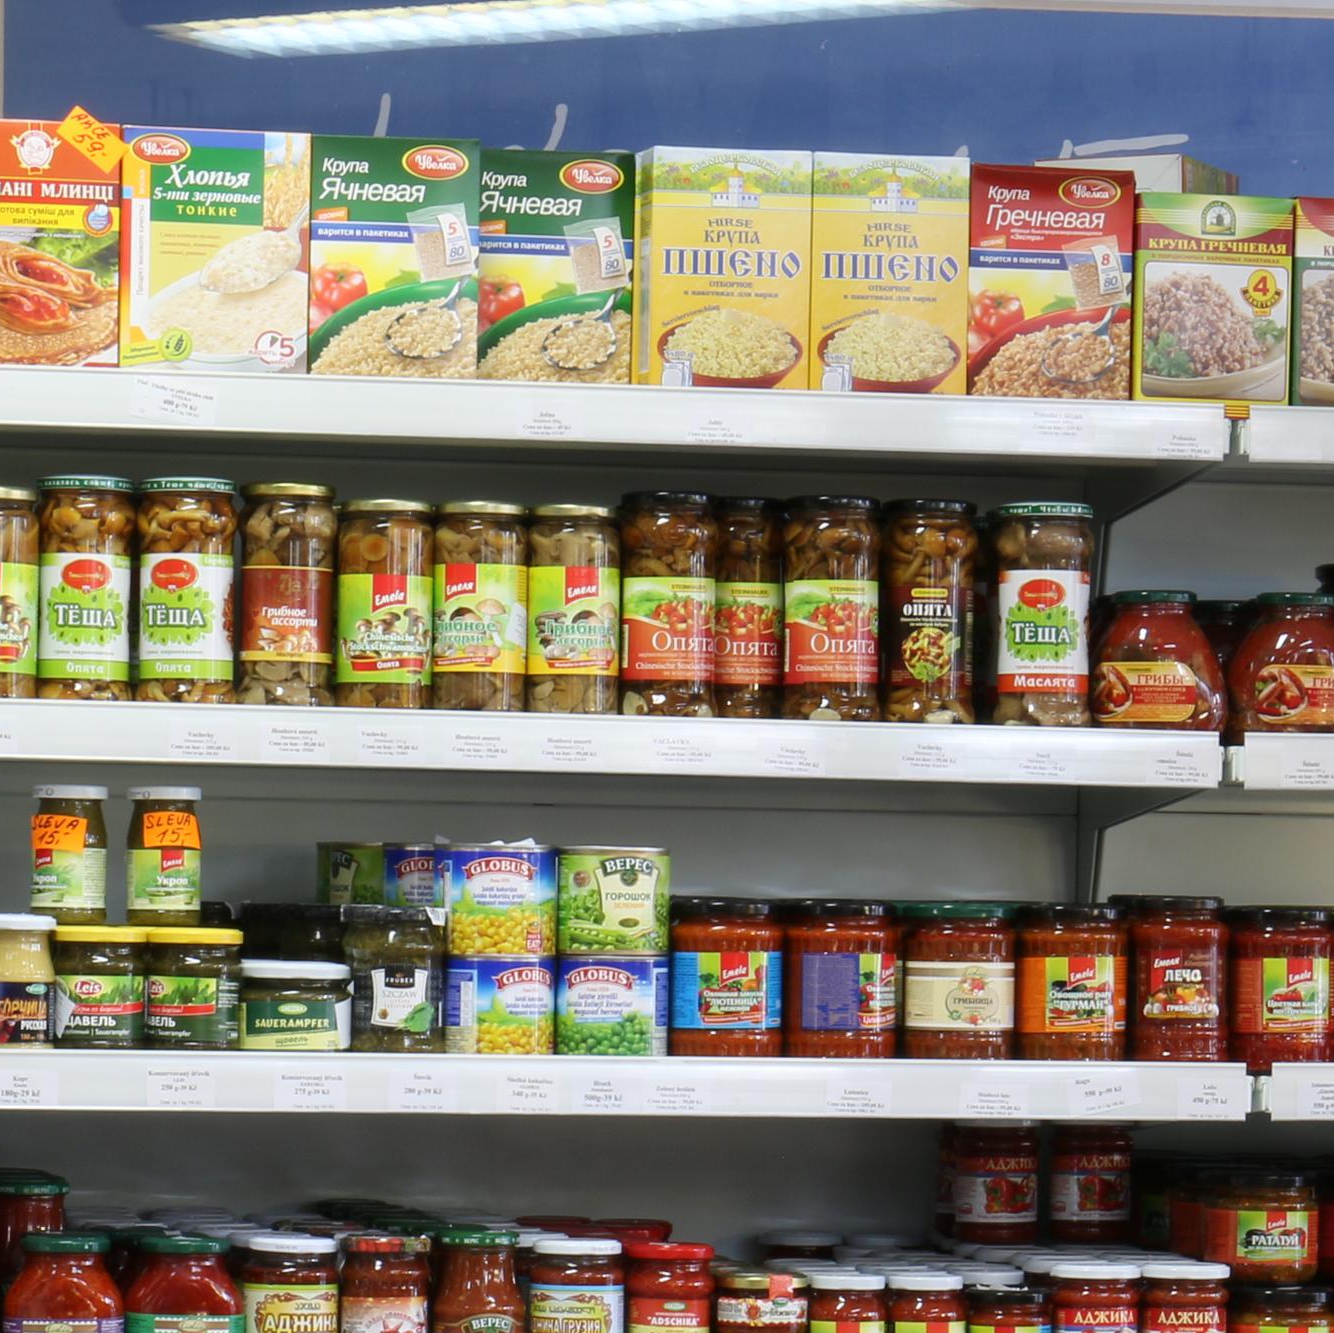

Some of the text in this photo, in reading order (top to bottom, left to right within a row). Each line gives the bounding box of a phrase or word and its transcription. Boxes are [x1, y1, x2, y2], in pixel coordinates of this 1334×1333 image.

[322, 157, 369, 176] Крупа
[41, 181, 113, 201] МЛИНЦІ
[319, 178, 426, 204] Ячневая
[12, 216, 59, 226] випікання
[868, 221, 912, 233] HIRSE
[862, 234, 905, 251] КРУПА
[1148, 238, 1287, 255] КРУПА ГРЕЧНЕВАЯ
[820, 251, 959, 283] ПШЕНО
[1100, 253, 1110, 267] 8
[1255, 275, 1269, 296] 4
[54, 602, 116, 628] ТЁЩА
[145, 602, 203, 627] ТЁЩА
[262, 605, 308, 618] Грибное
[902, 602, 952, 617] ОПЯТА
[271, 617, 318, 627] ассорти
[1013, 620, 1071, 646] ТЁЩА
[65, 662, 104, 674] Опята
[1013, 675, 1075, 690] Маслята
[1137, 673, 1185, 685] ГРИБЫ
[146, 813, 192, 829] SLEVA
[470, 858, 533, 877] GLOBUS
[604, 857, 653, 876] ВЕРЕС
[156, 874, 189, 886] Укроп
[605, 892, 651, 901] ГОРОШОК
[1164, 970, 1202, 983] ЛЕЧО
[75, 981, 102, 995] Leis
[254, 1017, 330, 1030] SAUERAMPFER
[1251, 1233, 1299, 1247] РАТАТУЙ
[647, 1315, 701, 1326] "ADSCHIKA"
[1074, 1310, 1135, 1325] АДЖИКА
